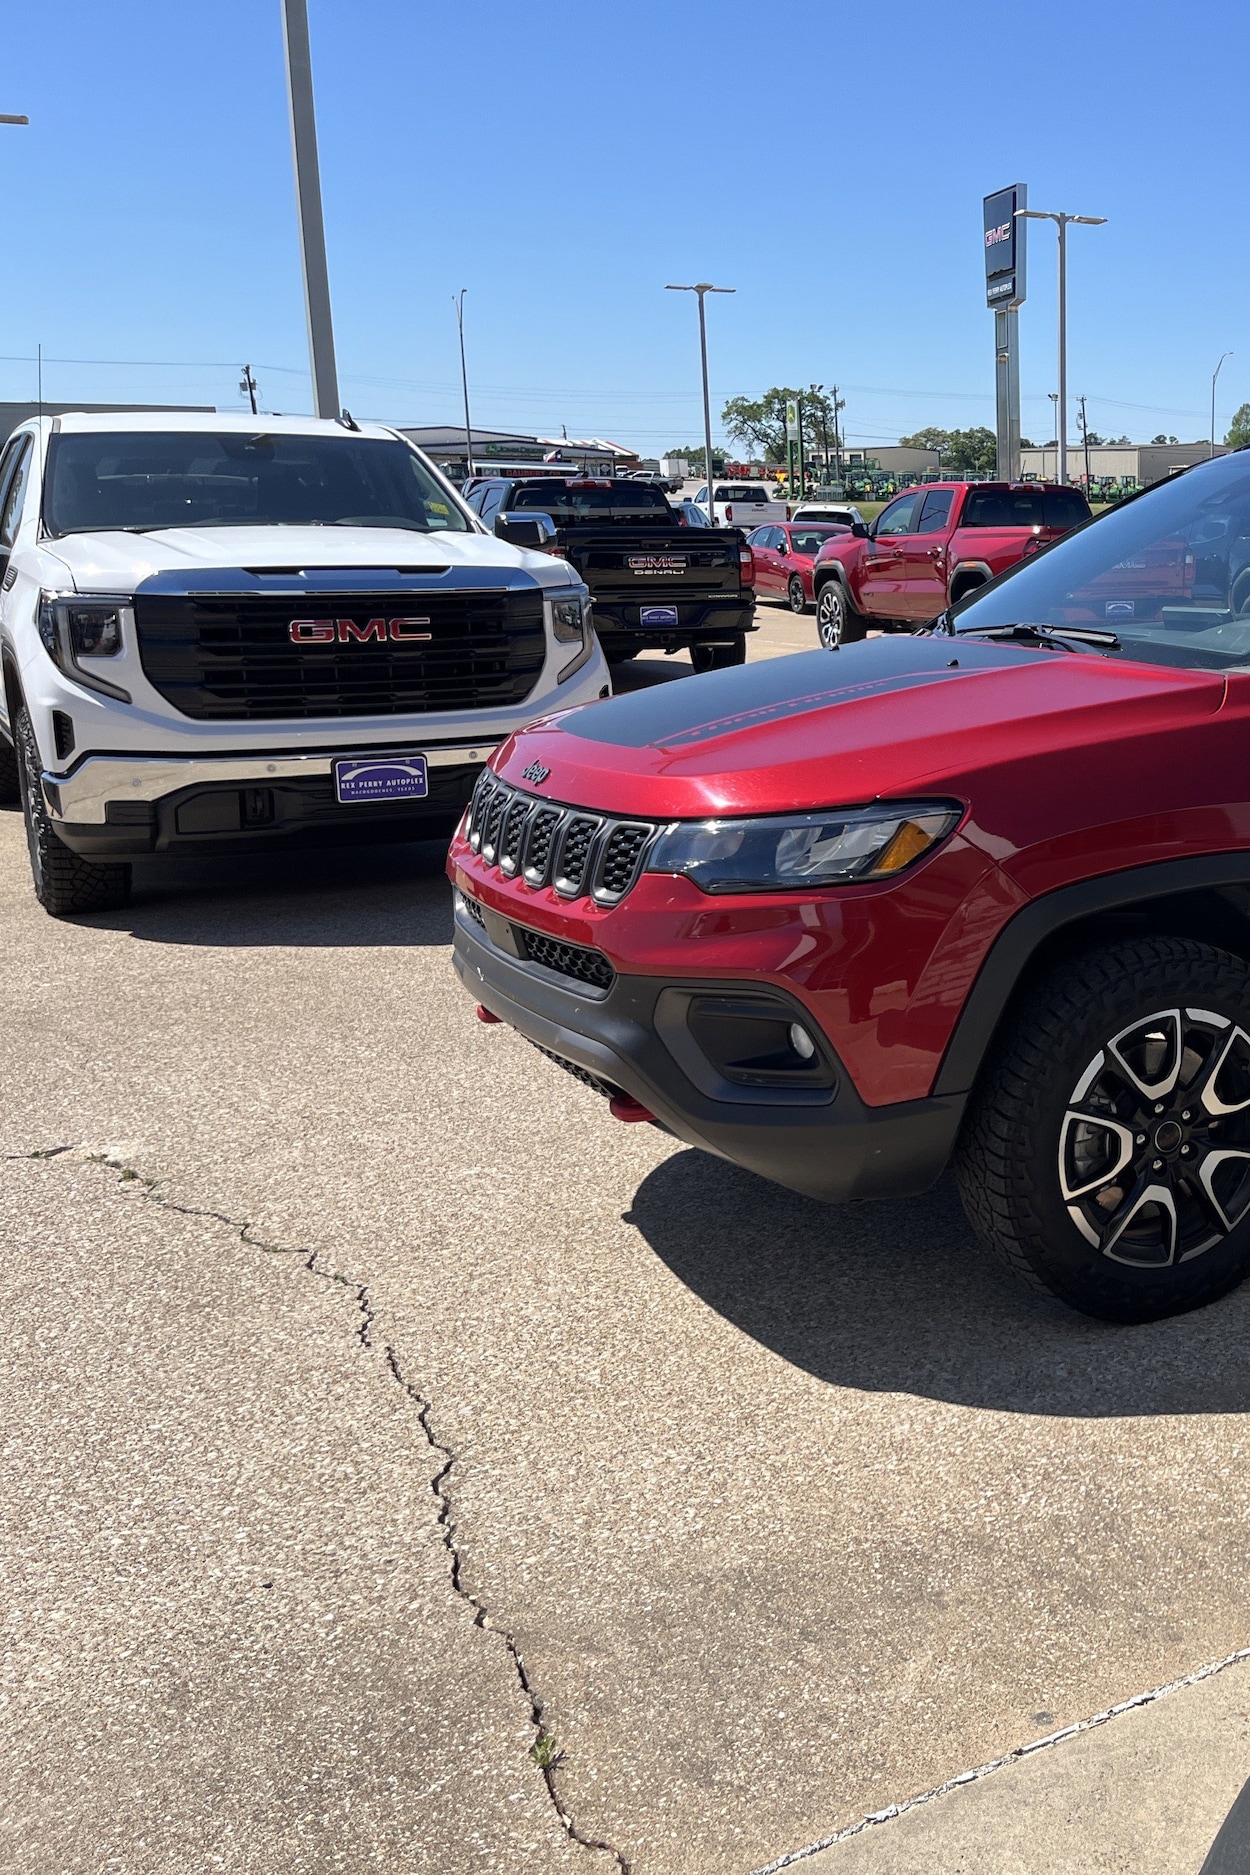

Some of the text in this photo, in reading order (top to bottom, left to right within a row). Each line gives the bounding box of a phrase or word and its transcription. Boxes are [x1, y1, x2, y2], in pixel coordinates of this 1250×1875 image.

[985, 222, 1011, 248] GMC
[628, 556, 687, 568] GMC
[289, 617, 432, 644] GMC
[359, 780, 383, 788] PERRY
[386, 777, 424, 786] AUTOPLEX
[522, 759, 552, 787] Jeep
